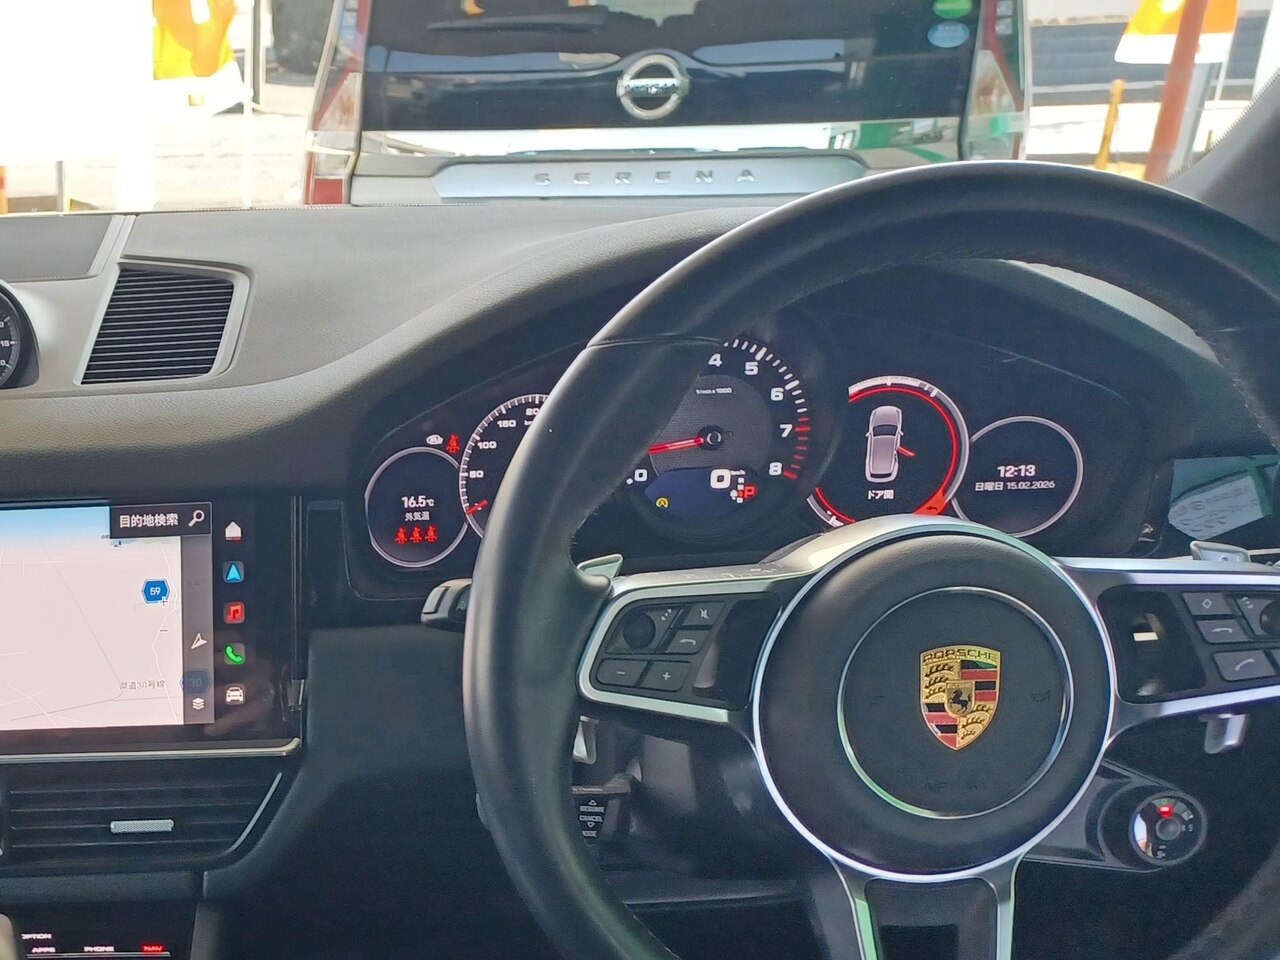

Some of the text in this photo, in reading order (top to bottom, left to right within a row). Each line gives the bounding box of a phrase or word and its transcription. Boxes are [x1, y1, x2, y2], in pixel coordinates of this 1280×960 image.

[533, 169, 755, 185] SERENA
[708, 353, 723, 367] 4
[744, 361, 759, 376] 5
[770, 388, 784, 401] 6
[497, 420, 517, 428] 150
[779, 424, 793, 438] 7
[477, 441, 497, 449] 100
[469, 470, 484, 478] 50
[634, 469, 648, 482] 0
[769, 462, 782, 476] 8
[997, 465, 1036, 478] 12:13
[710, 469, 731, 489] 0
[744, 486, 756, 498] P
[975, 481, 1056, 491] 日曜日 15.02.2026
[868, 490, 894, 500] ドア開
[119, 513, 179, 528] 目的地検索
[405, 512, 430, 521] 外気温
[150, 587, 161, 595] 59
[923, 648, 997, 662] PORSCHE
[190, 678, 202, 686] 30
